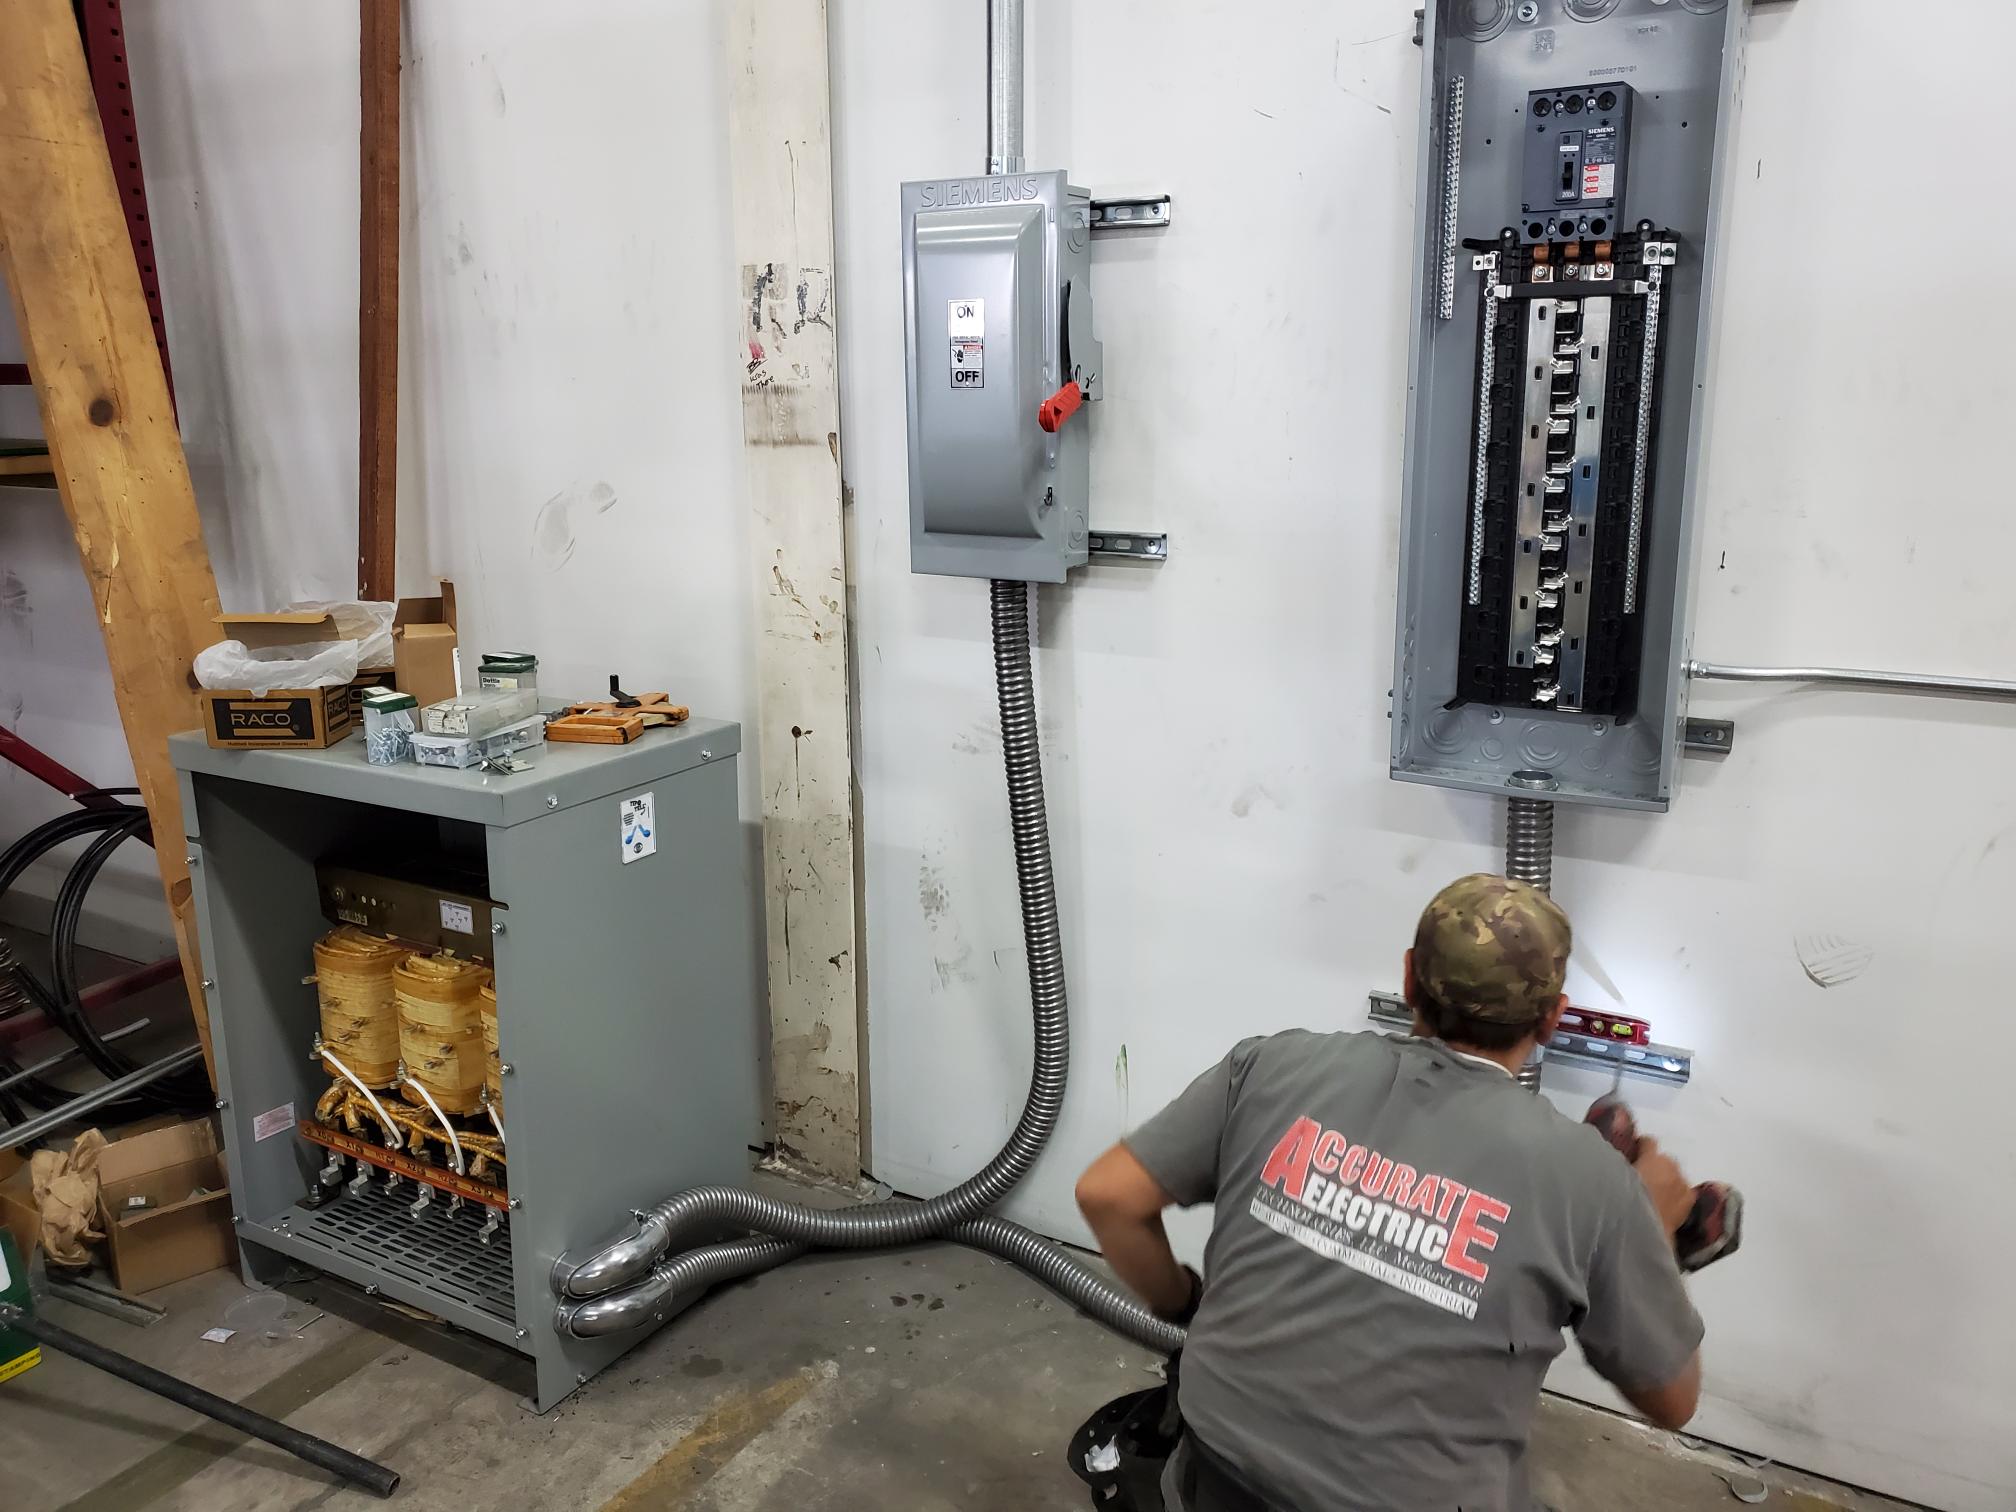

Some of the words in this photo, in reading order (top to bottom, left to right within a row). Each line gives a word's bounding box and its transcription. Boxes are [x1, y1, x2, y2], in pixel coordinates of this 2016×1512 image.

[1588, 126, 1615, 135] SIEMENS
[921, 176, 1039, 207] SIEMENS
[957, 305, 975, 318] ON
[955, 371, 979, 382] OFF
[328, 696, 347, 717] RACO
[231, 712, 291, 726] RACO
[471, 1185, 481, 1194] X3
[1260, 1115, 1511, 1283] ACCURATE
[1302, 1173, 1450, 1262] ELECTRIC
[1399, 1273, 1476, 1320] INDUSTRIAL
